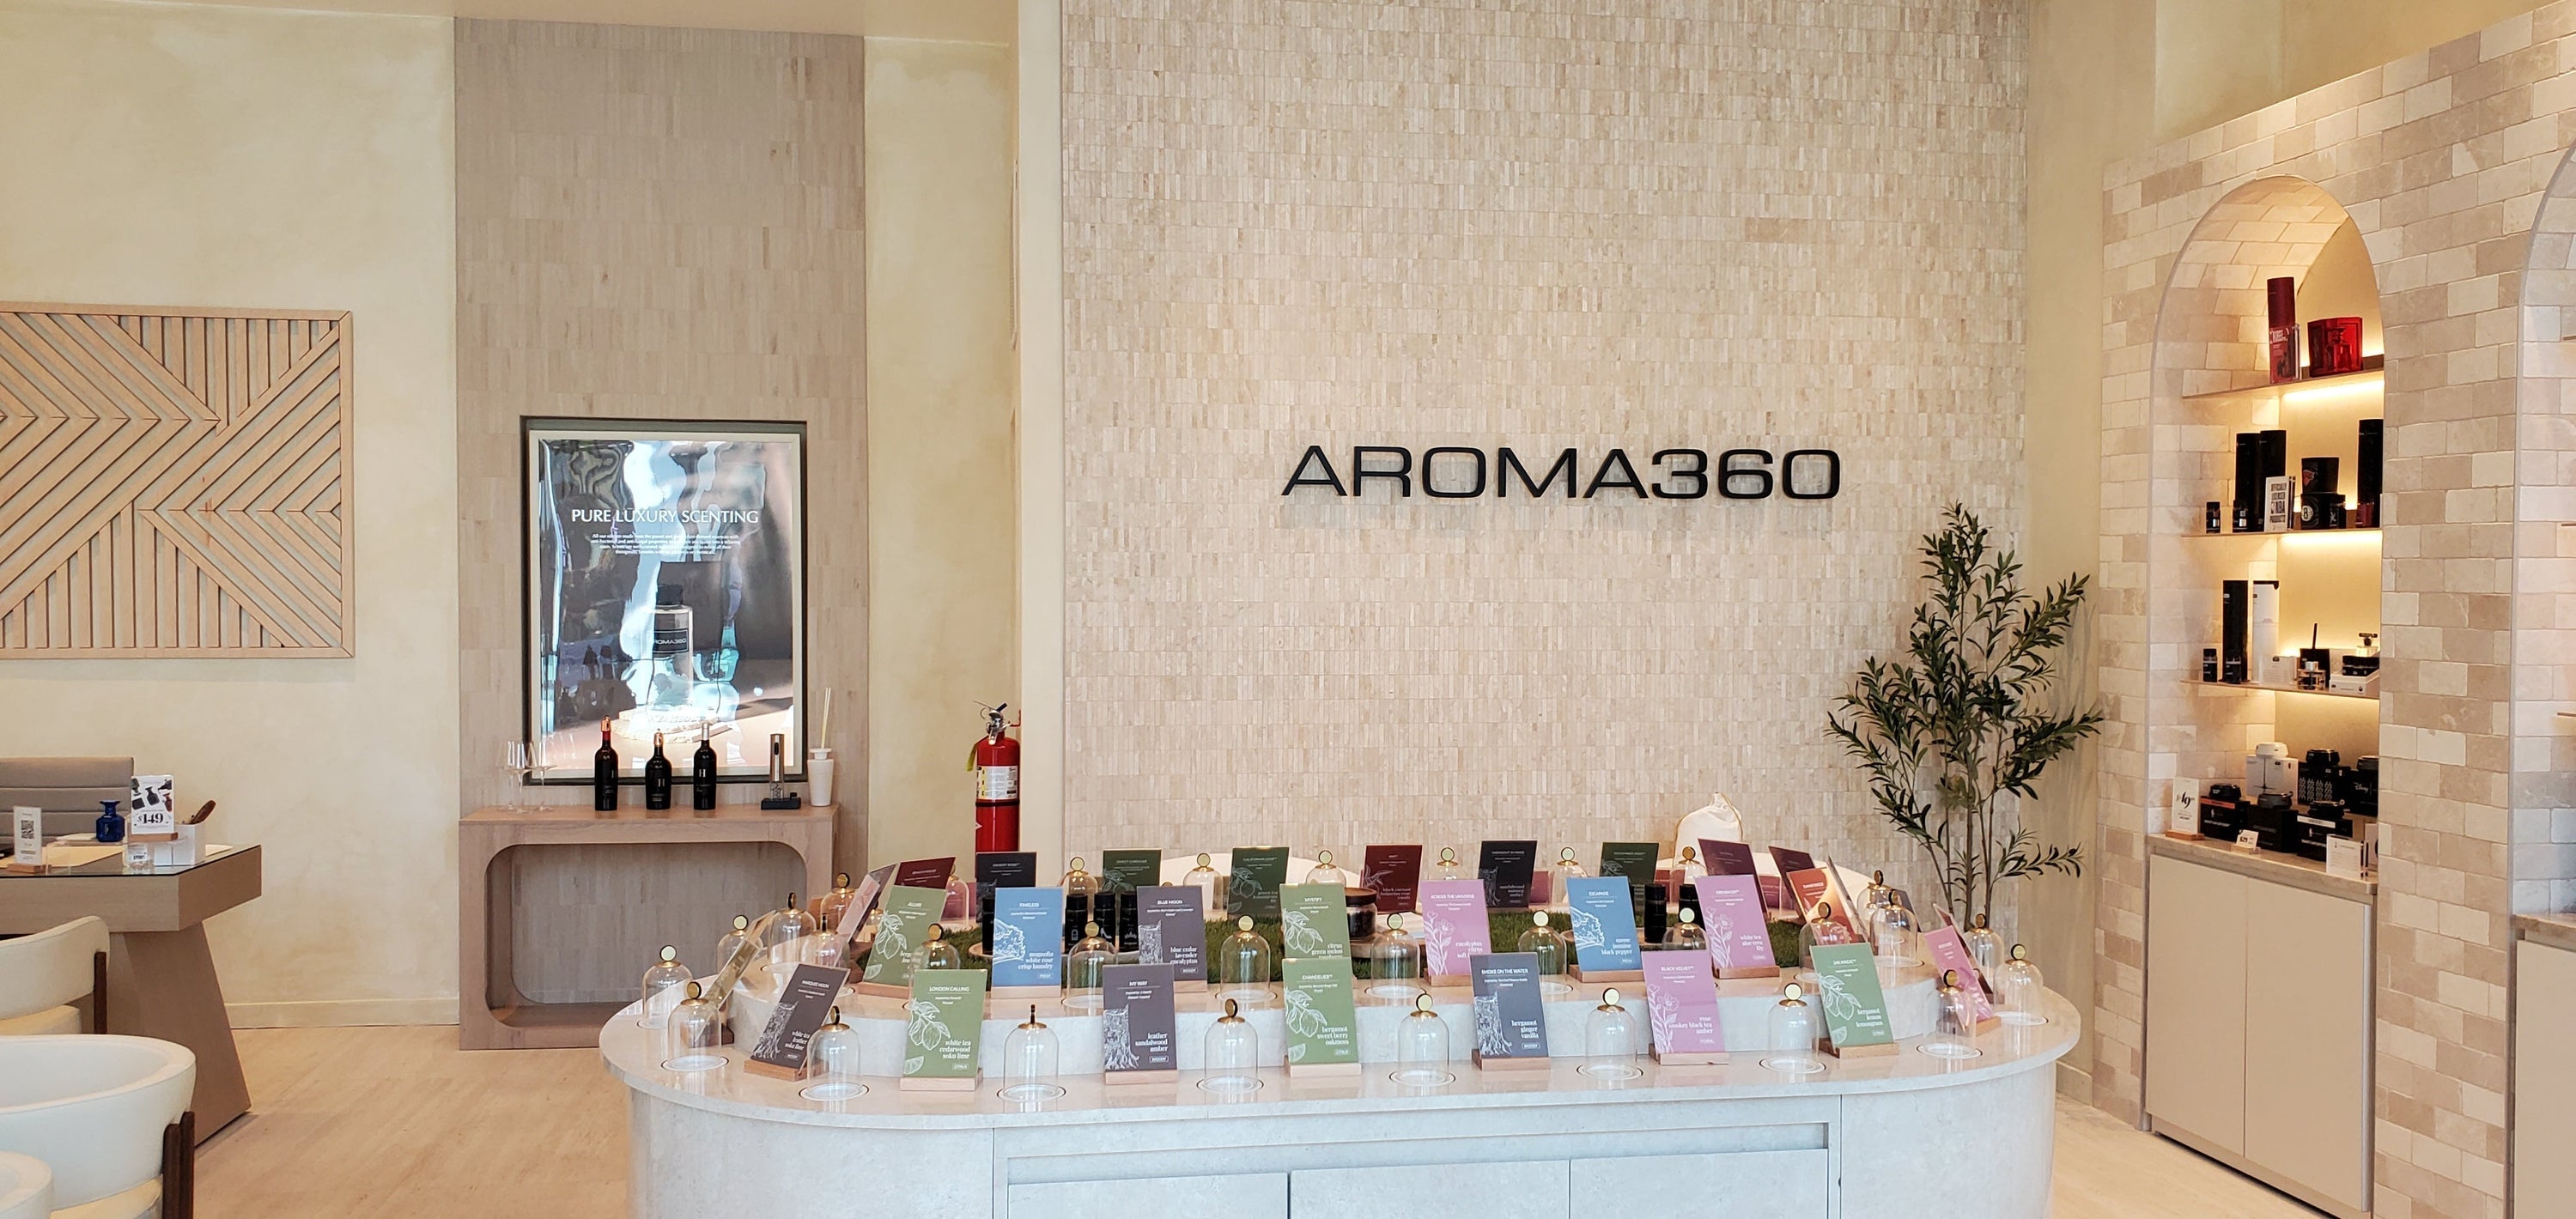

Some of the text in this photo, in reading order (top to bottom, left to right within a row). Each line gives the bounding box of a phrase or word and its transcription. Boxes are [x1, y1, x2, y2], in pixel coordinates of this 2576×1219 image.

[1281, 445, 1841, 500] AROMA360
[572, 509, 611, 522] PURE
[682, 510, 759, 524] SCENTING
[137, 813, 163, 824] $149
